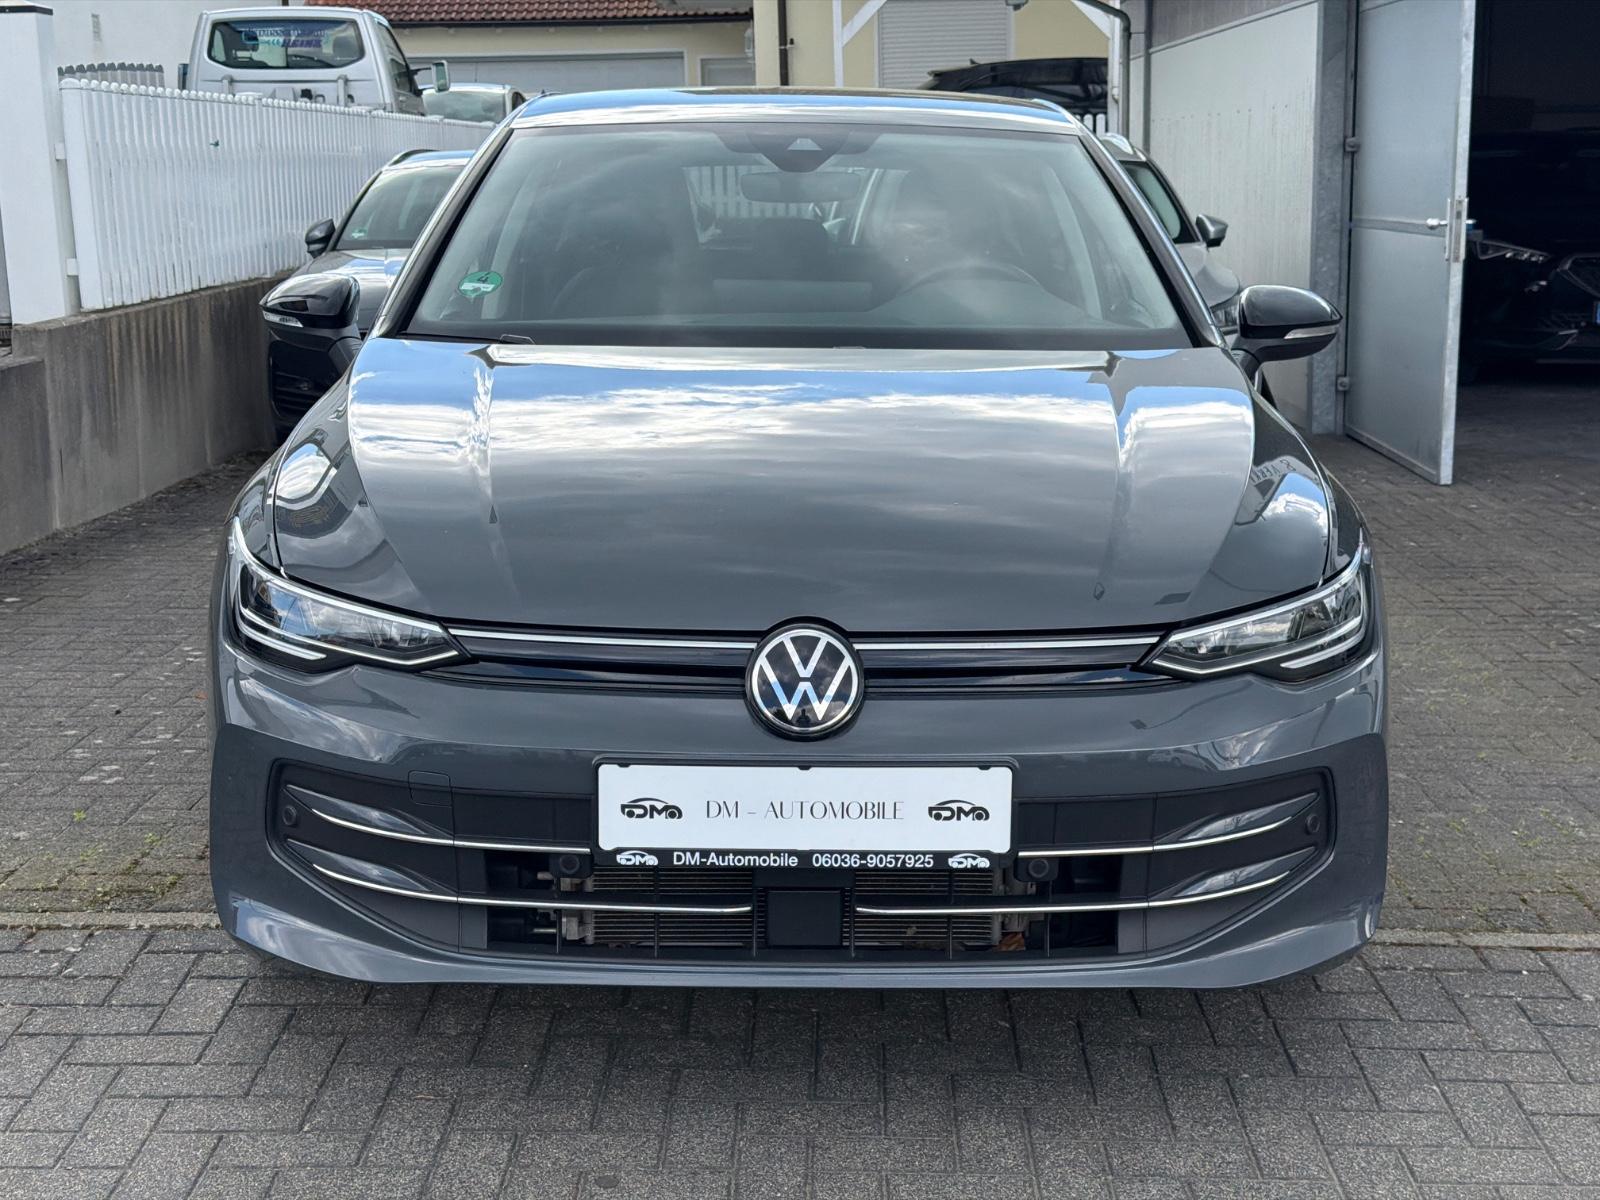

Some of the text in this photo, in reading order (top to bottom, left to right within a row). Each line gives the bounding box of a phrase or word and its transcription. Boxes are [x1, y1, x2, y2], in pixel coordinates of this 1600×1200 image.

[477, 272, 489, 284] 4
[706, 799, 739, 819] DM
[764, 800, 904, 820] AUTOMOBILE
[673, 851, 934, 868] DM-Automobile 06036-9057925
